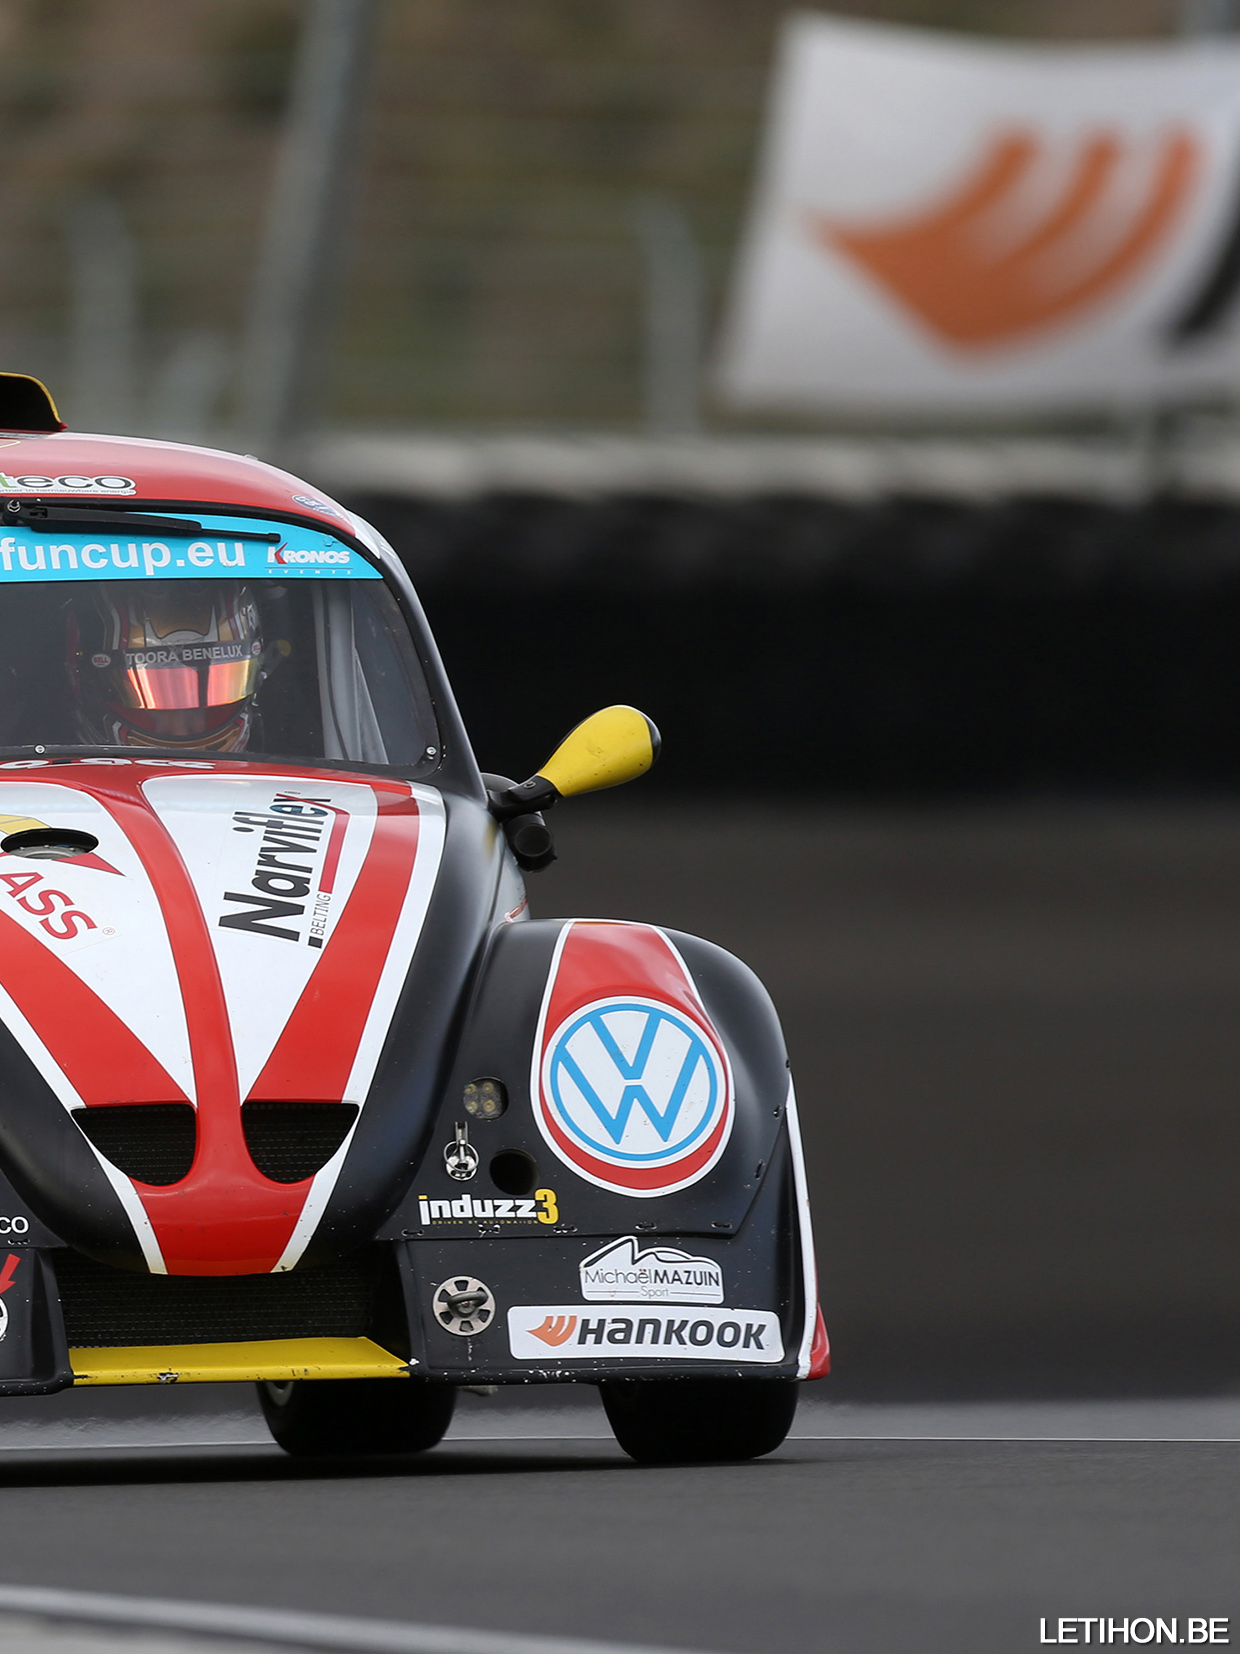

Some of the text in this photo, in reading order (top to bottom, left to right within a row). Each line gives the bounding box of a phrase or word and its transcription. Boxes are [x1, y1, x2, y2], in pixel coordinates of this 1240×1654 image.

[267, 542, 351, 565] KRONOS
[126, 650, 179, 666] TOORA
[183, 645, 244, 662] BENELUX
[218, 793, 333, 942] Narviflex
[310, 893, 332, 936] BELTING
[418, 1188, 559, 1225] induzz3
[640, 1285, 669, 1299] Sport
